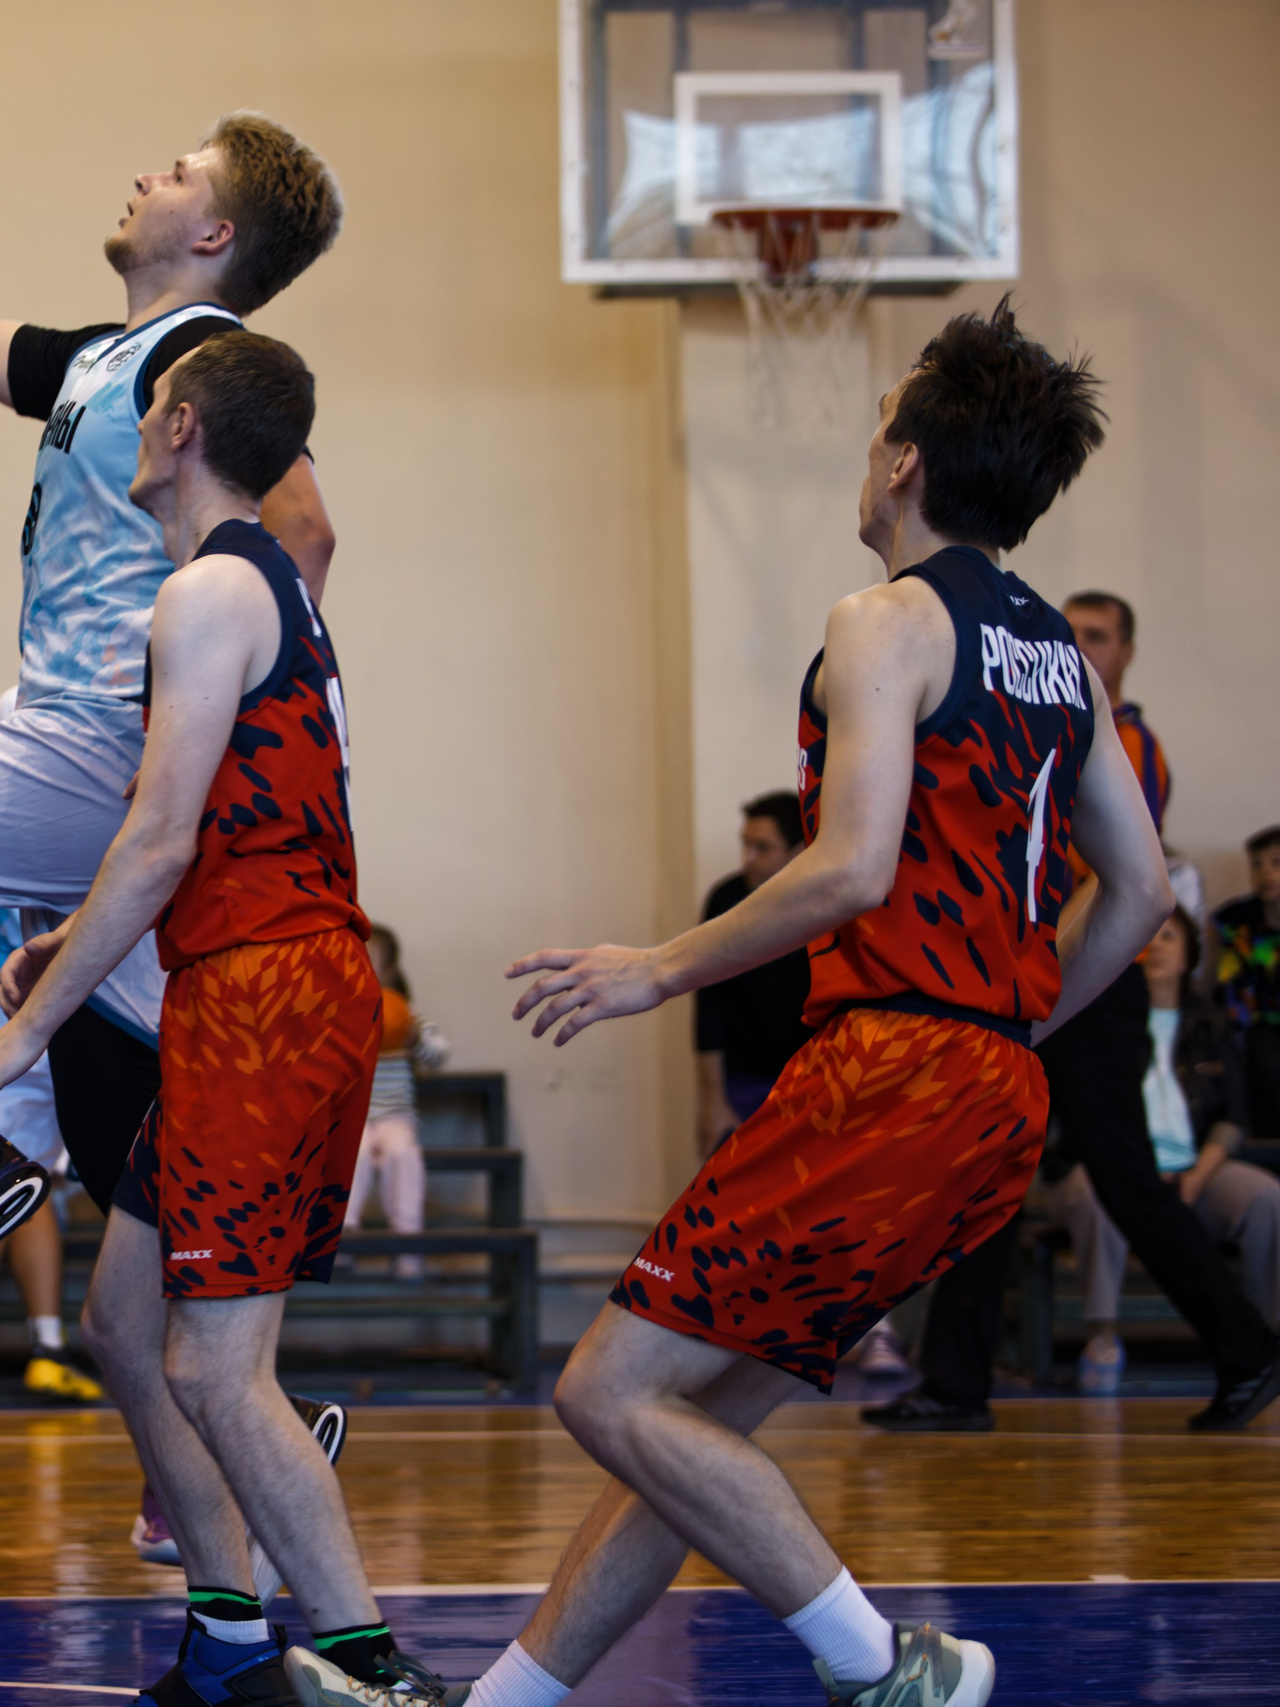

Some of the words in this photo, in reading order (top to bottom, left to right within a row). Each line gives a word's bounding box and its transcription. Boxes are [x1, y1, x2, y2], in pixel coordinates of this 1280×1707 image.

[1026, 748, 1056, 922] 1
[171, 1249, 213, 1260] MAXX
[633, 1256, 676, 1282] MAXX
